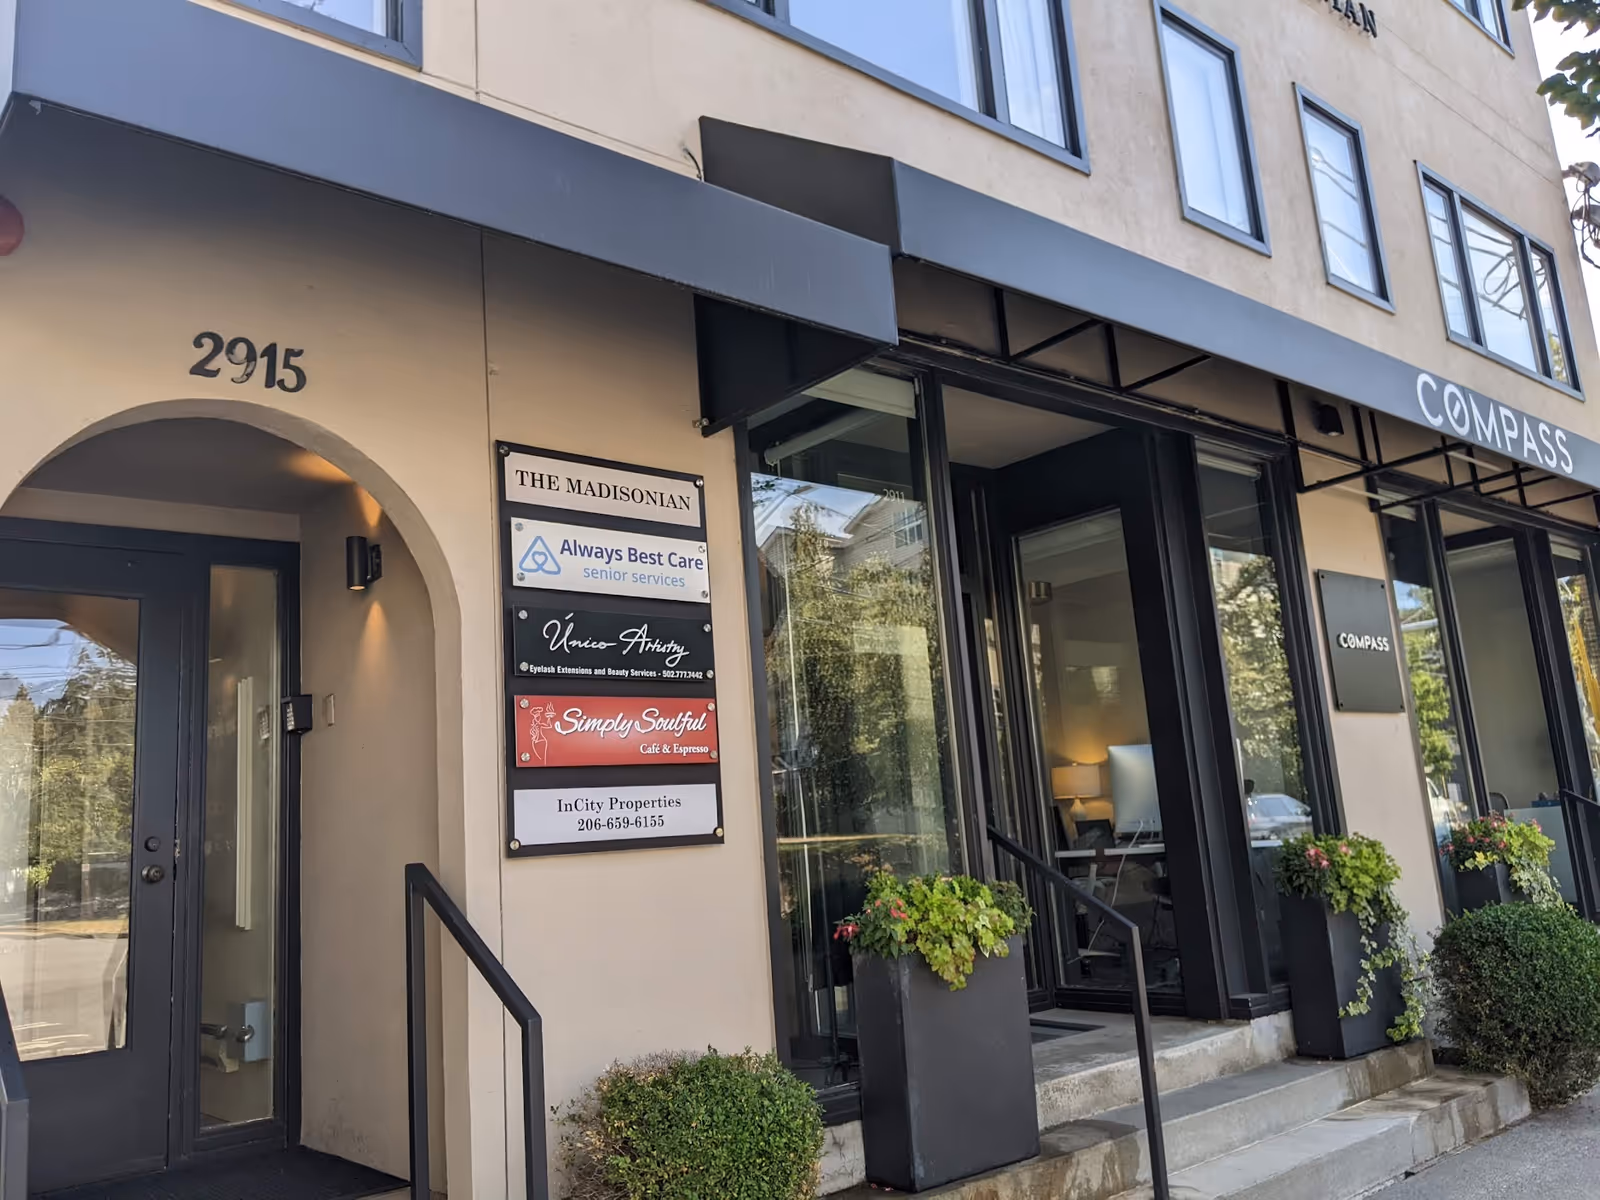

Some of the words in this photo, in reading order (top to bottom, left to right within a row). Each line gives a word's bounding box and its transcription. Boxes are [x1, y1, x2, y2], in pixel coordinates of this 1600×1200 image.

[189, 331, 307, 393] 2915
[515, 469, 560, 491] THE
[566, 477, 691, 511] MADISONIAN
[883, 488, 905, 504] 2911
[560, 539, 623, 565] Always
[627, 547, 664, 566] Best
[668, 552, 704, 570] Care
[583, 567, 628, 581] senior
[632, 573, 685, 588] services
[619, 623, 690, 667] Artistry
[1339, 632, 1389, 651] COMPASS
[529, 664, 556, 675] Eyelash
[557, 665, 593, 675] Extensions
[594, 667, 606, 676] and
[607, 668, 629, 678] Beauty
[630, 668, 657, 677] Services
[555, 708, 634, 738] Simply
[634, 708, 707, 738] Soulful
[640, 743, 660, 754] Café
[662, 745, 671, 754] &
[673, 744, 709, 756] Espresso
[557, 798, 604, 814] InCity
[609, 795, 682, 813] Properties
[577, 815, 665, 832] 206-659-6155
